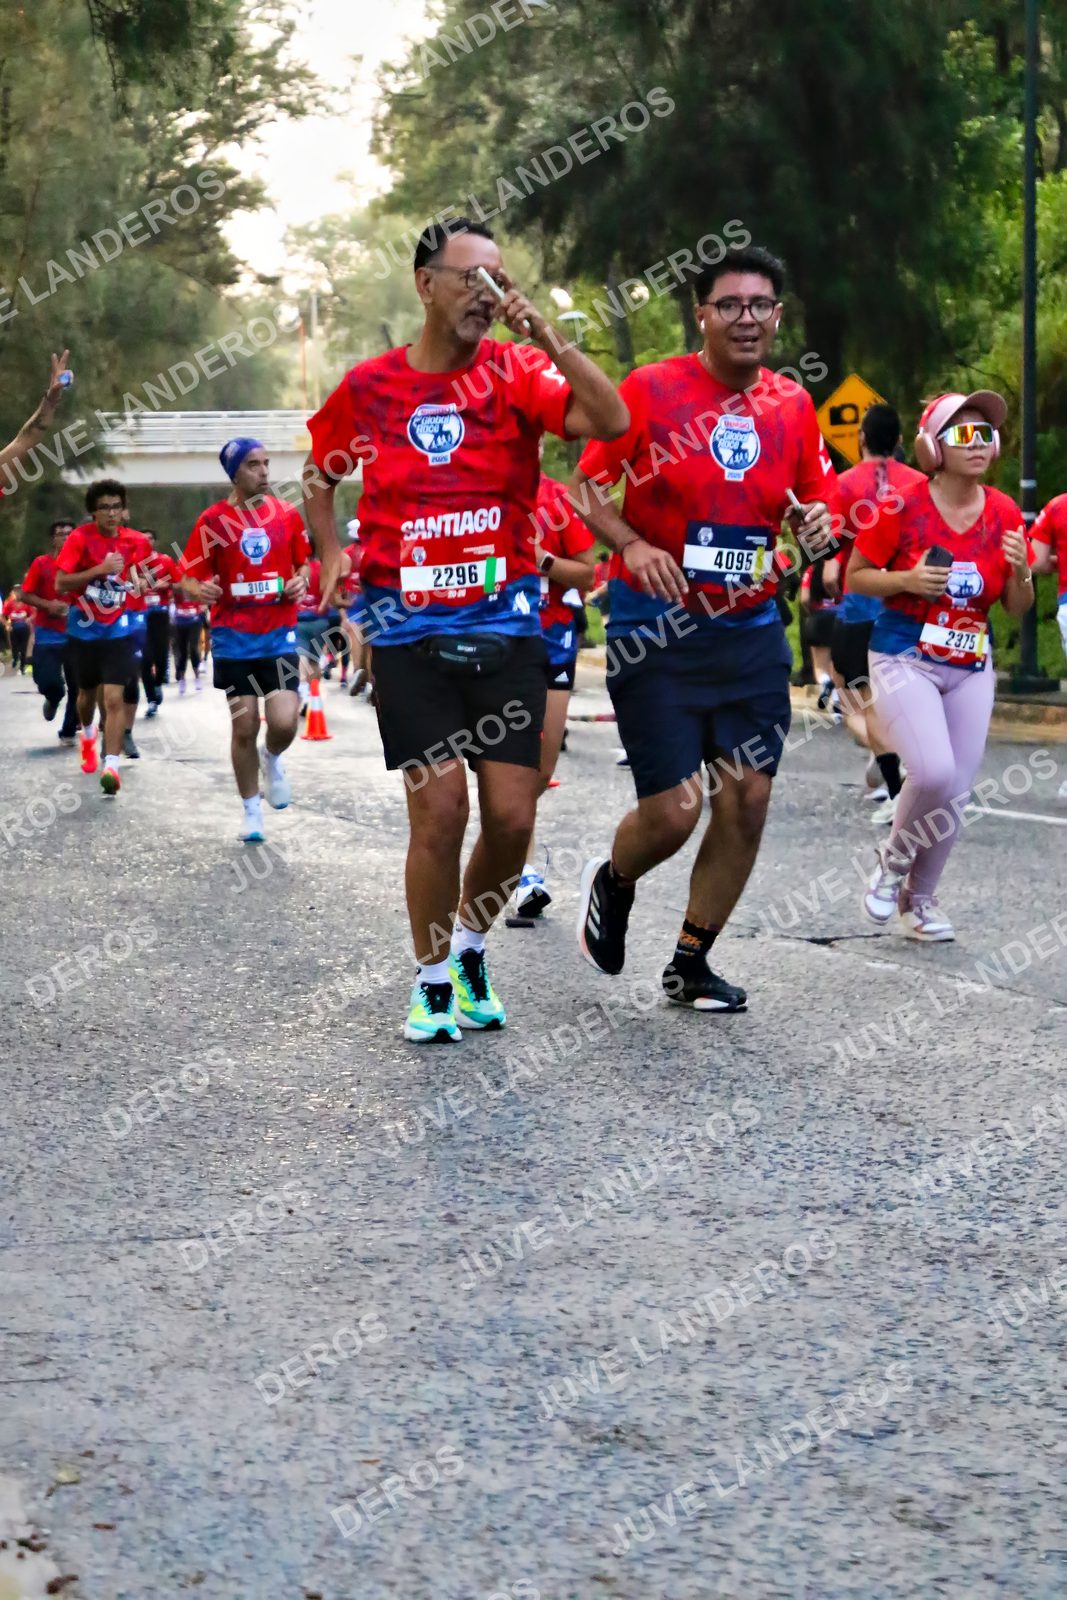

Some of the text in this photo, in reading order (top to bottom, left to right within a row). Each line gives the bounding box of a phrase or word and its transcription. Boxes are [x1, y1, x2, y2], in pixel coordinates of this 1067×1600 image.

[401, 506, 501, 541] SANTIAGO
[714, 550, 753, 571] 4095
[433, 564, 479, 588] 2296
[248, 581, 270, 594] 3104
[945, 631, 976, 650] 2375
